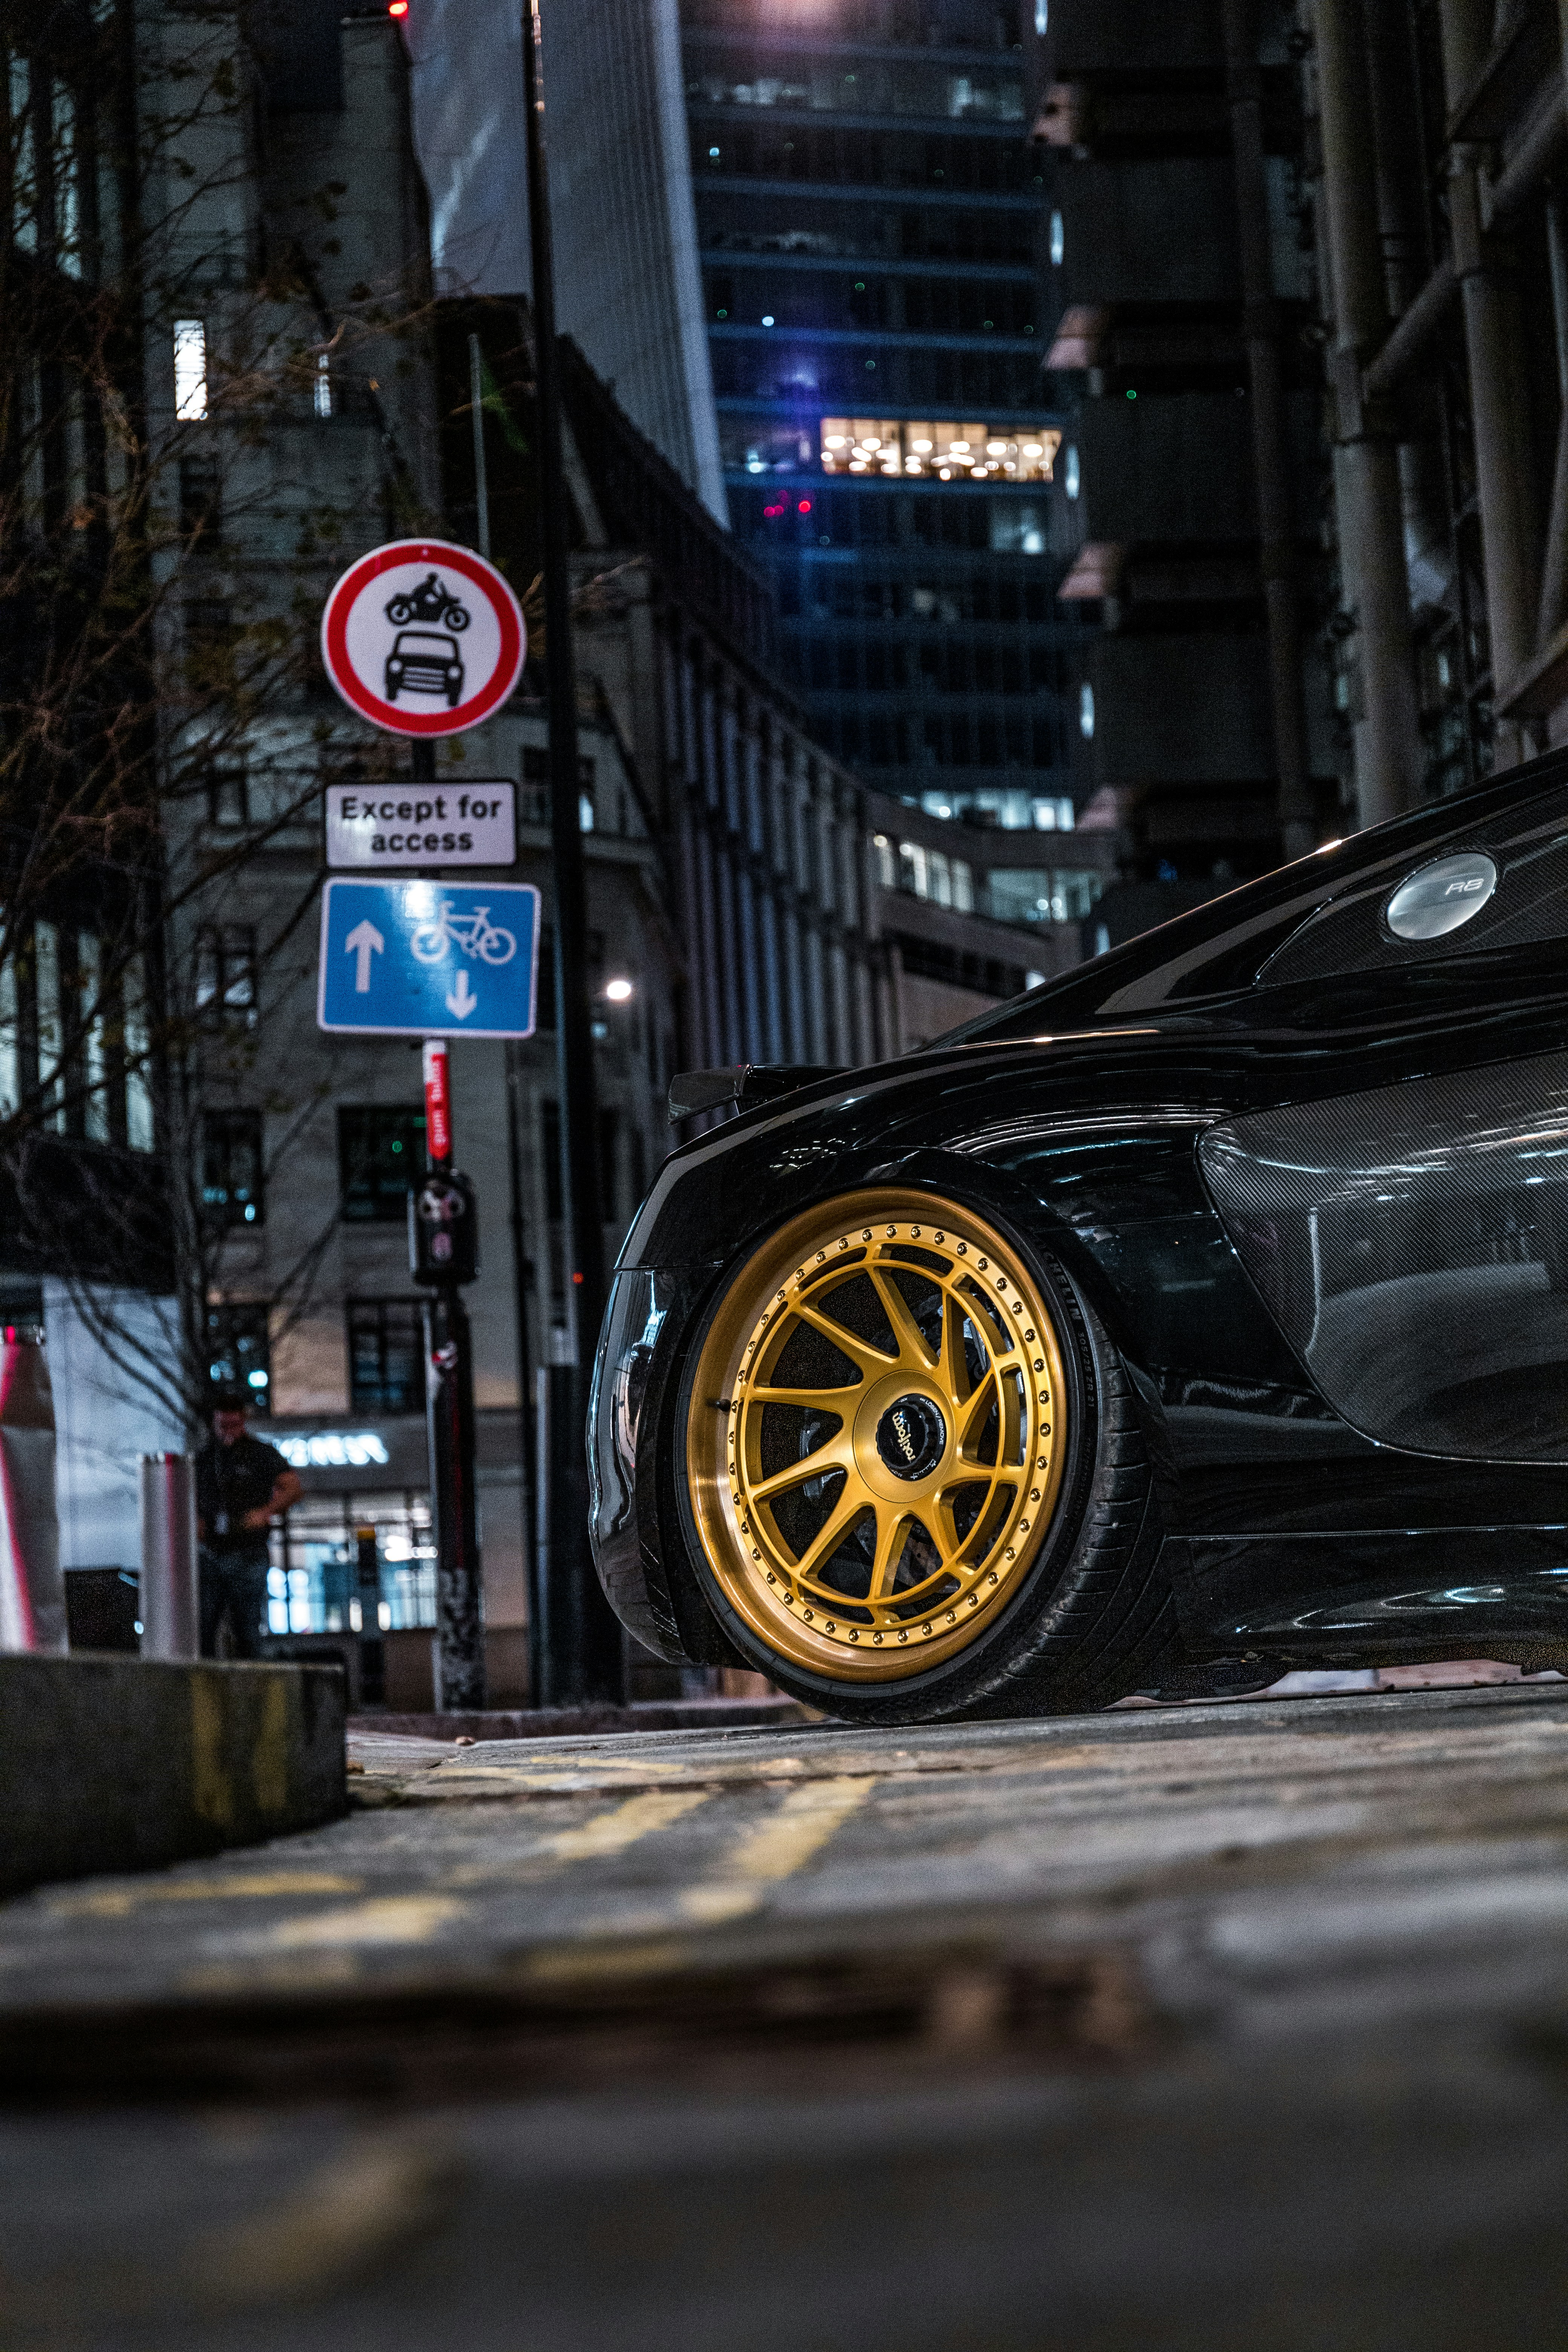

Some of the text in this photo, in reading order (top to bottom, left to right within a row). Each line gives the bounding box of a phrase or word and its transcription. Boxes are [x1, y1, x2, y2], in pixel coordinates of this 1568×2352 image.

[340, 794, 502, 824] Except for
[371, 832, 473, 852] access
[1445, 878, 1484, 896] R8
[1077, 1331, 1091, 1372] 305/25
[1087, 1395, 1095, 1407] 21
[892, 1412, 916, 1461] rotiform
